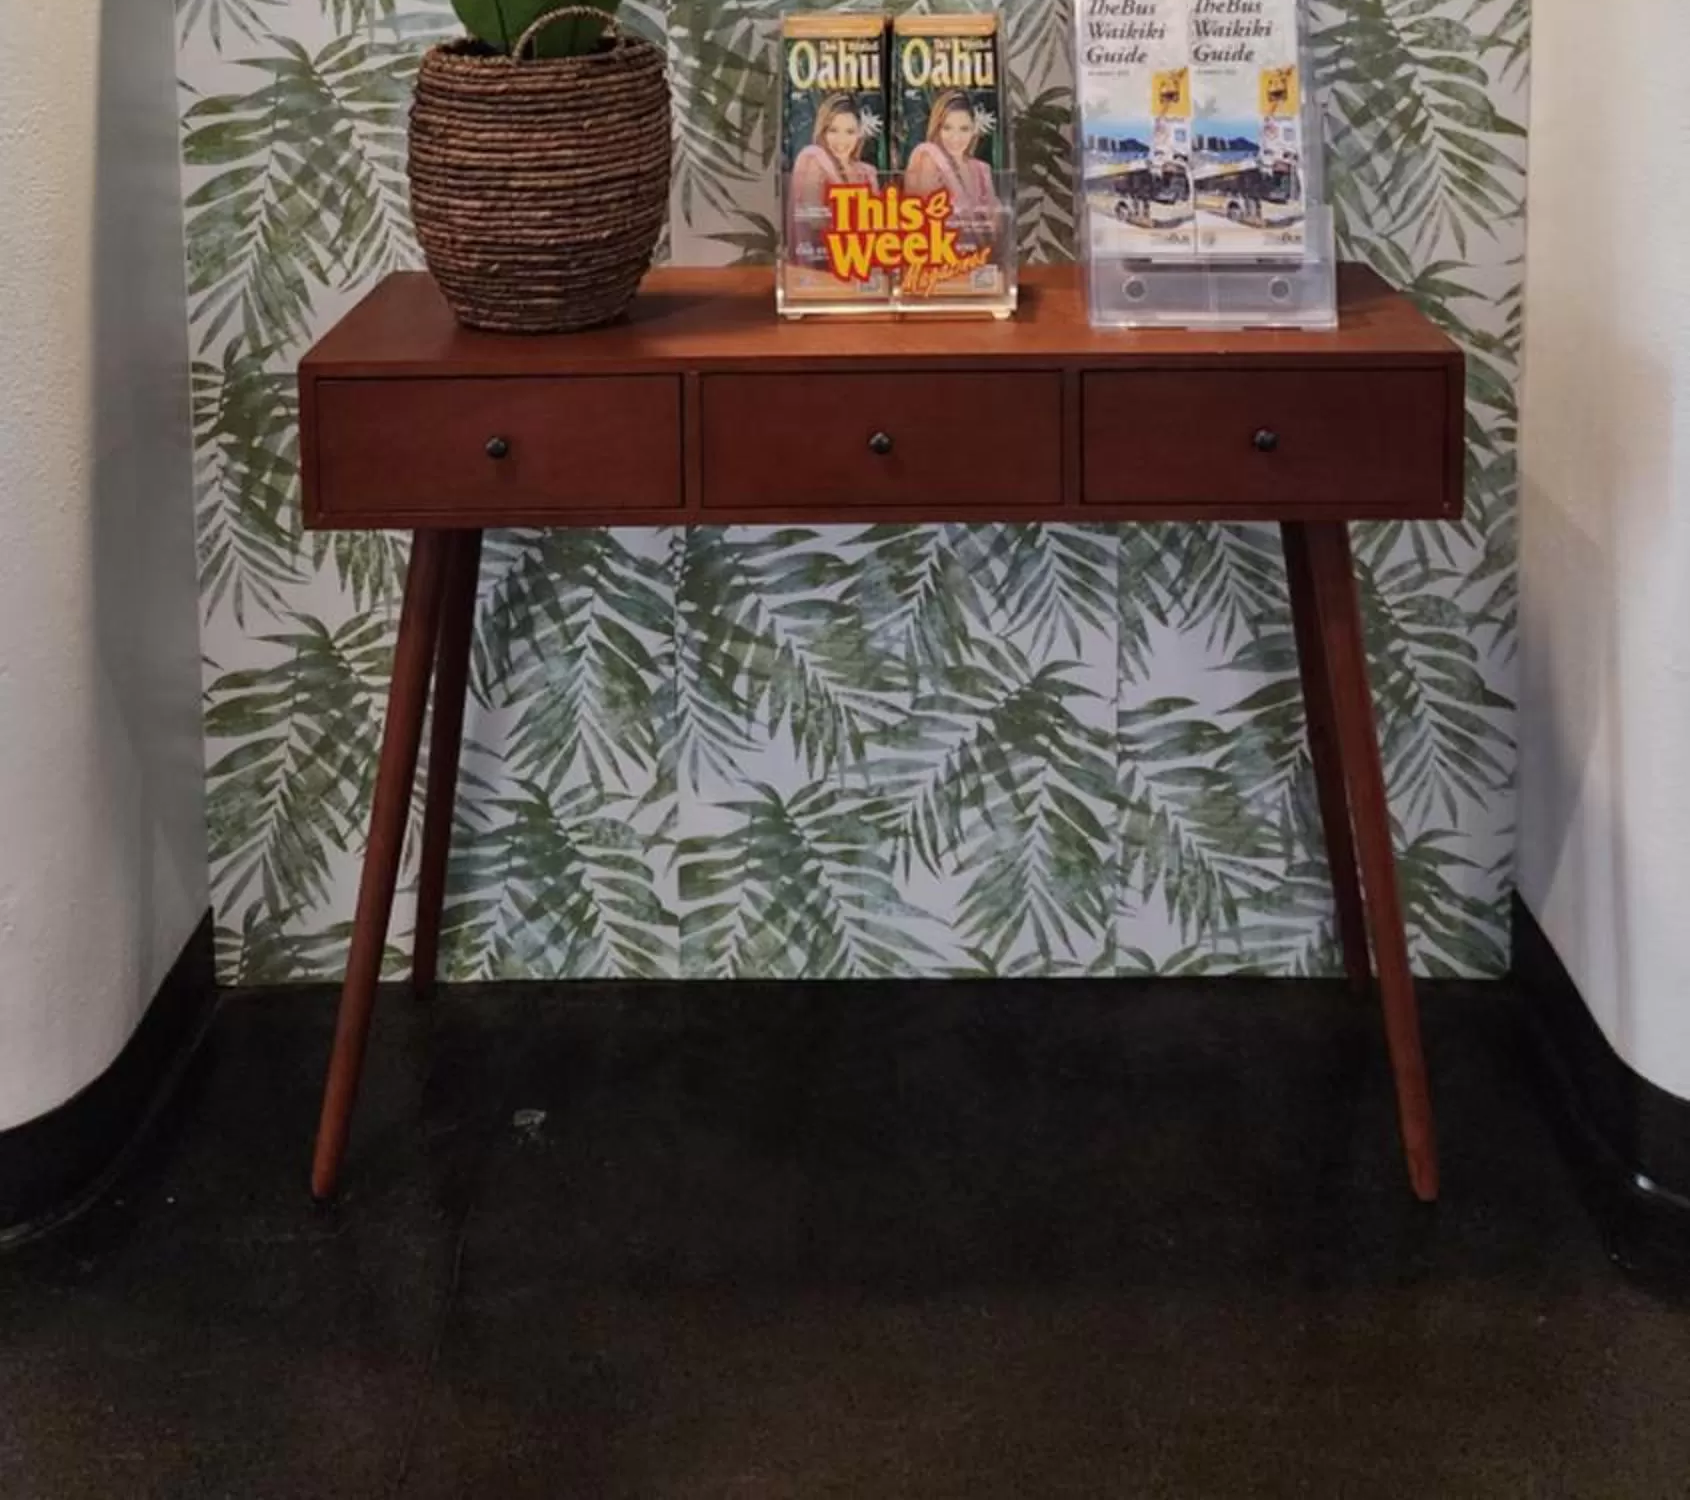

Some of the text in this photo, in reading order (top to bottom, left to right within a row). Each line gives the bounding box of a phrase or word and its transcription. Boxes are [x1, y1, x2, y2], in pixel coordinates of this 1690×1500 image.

[1088, 20, 1167, 40] Waikiki
[1192, 18, 1273, 37] Waikiki
[1086, 44, 1148, 65] Guide
[1192, 42, 1255, 63] Guide
[828, 185, 926, 232] This
[826, 218, 959, 279] Week
